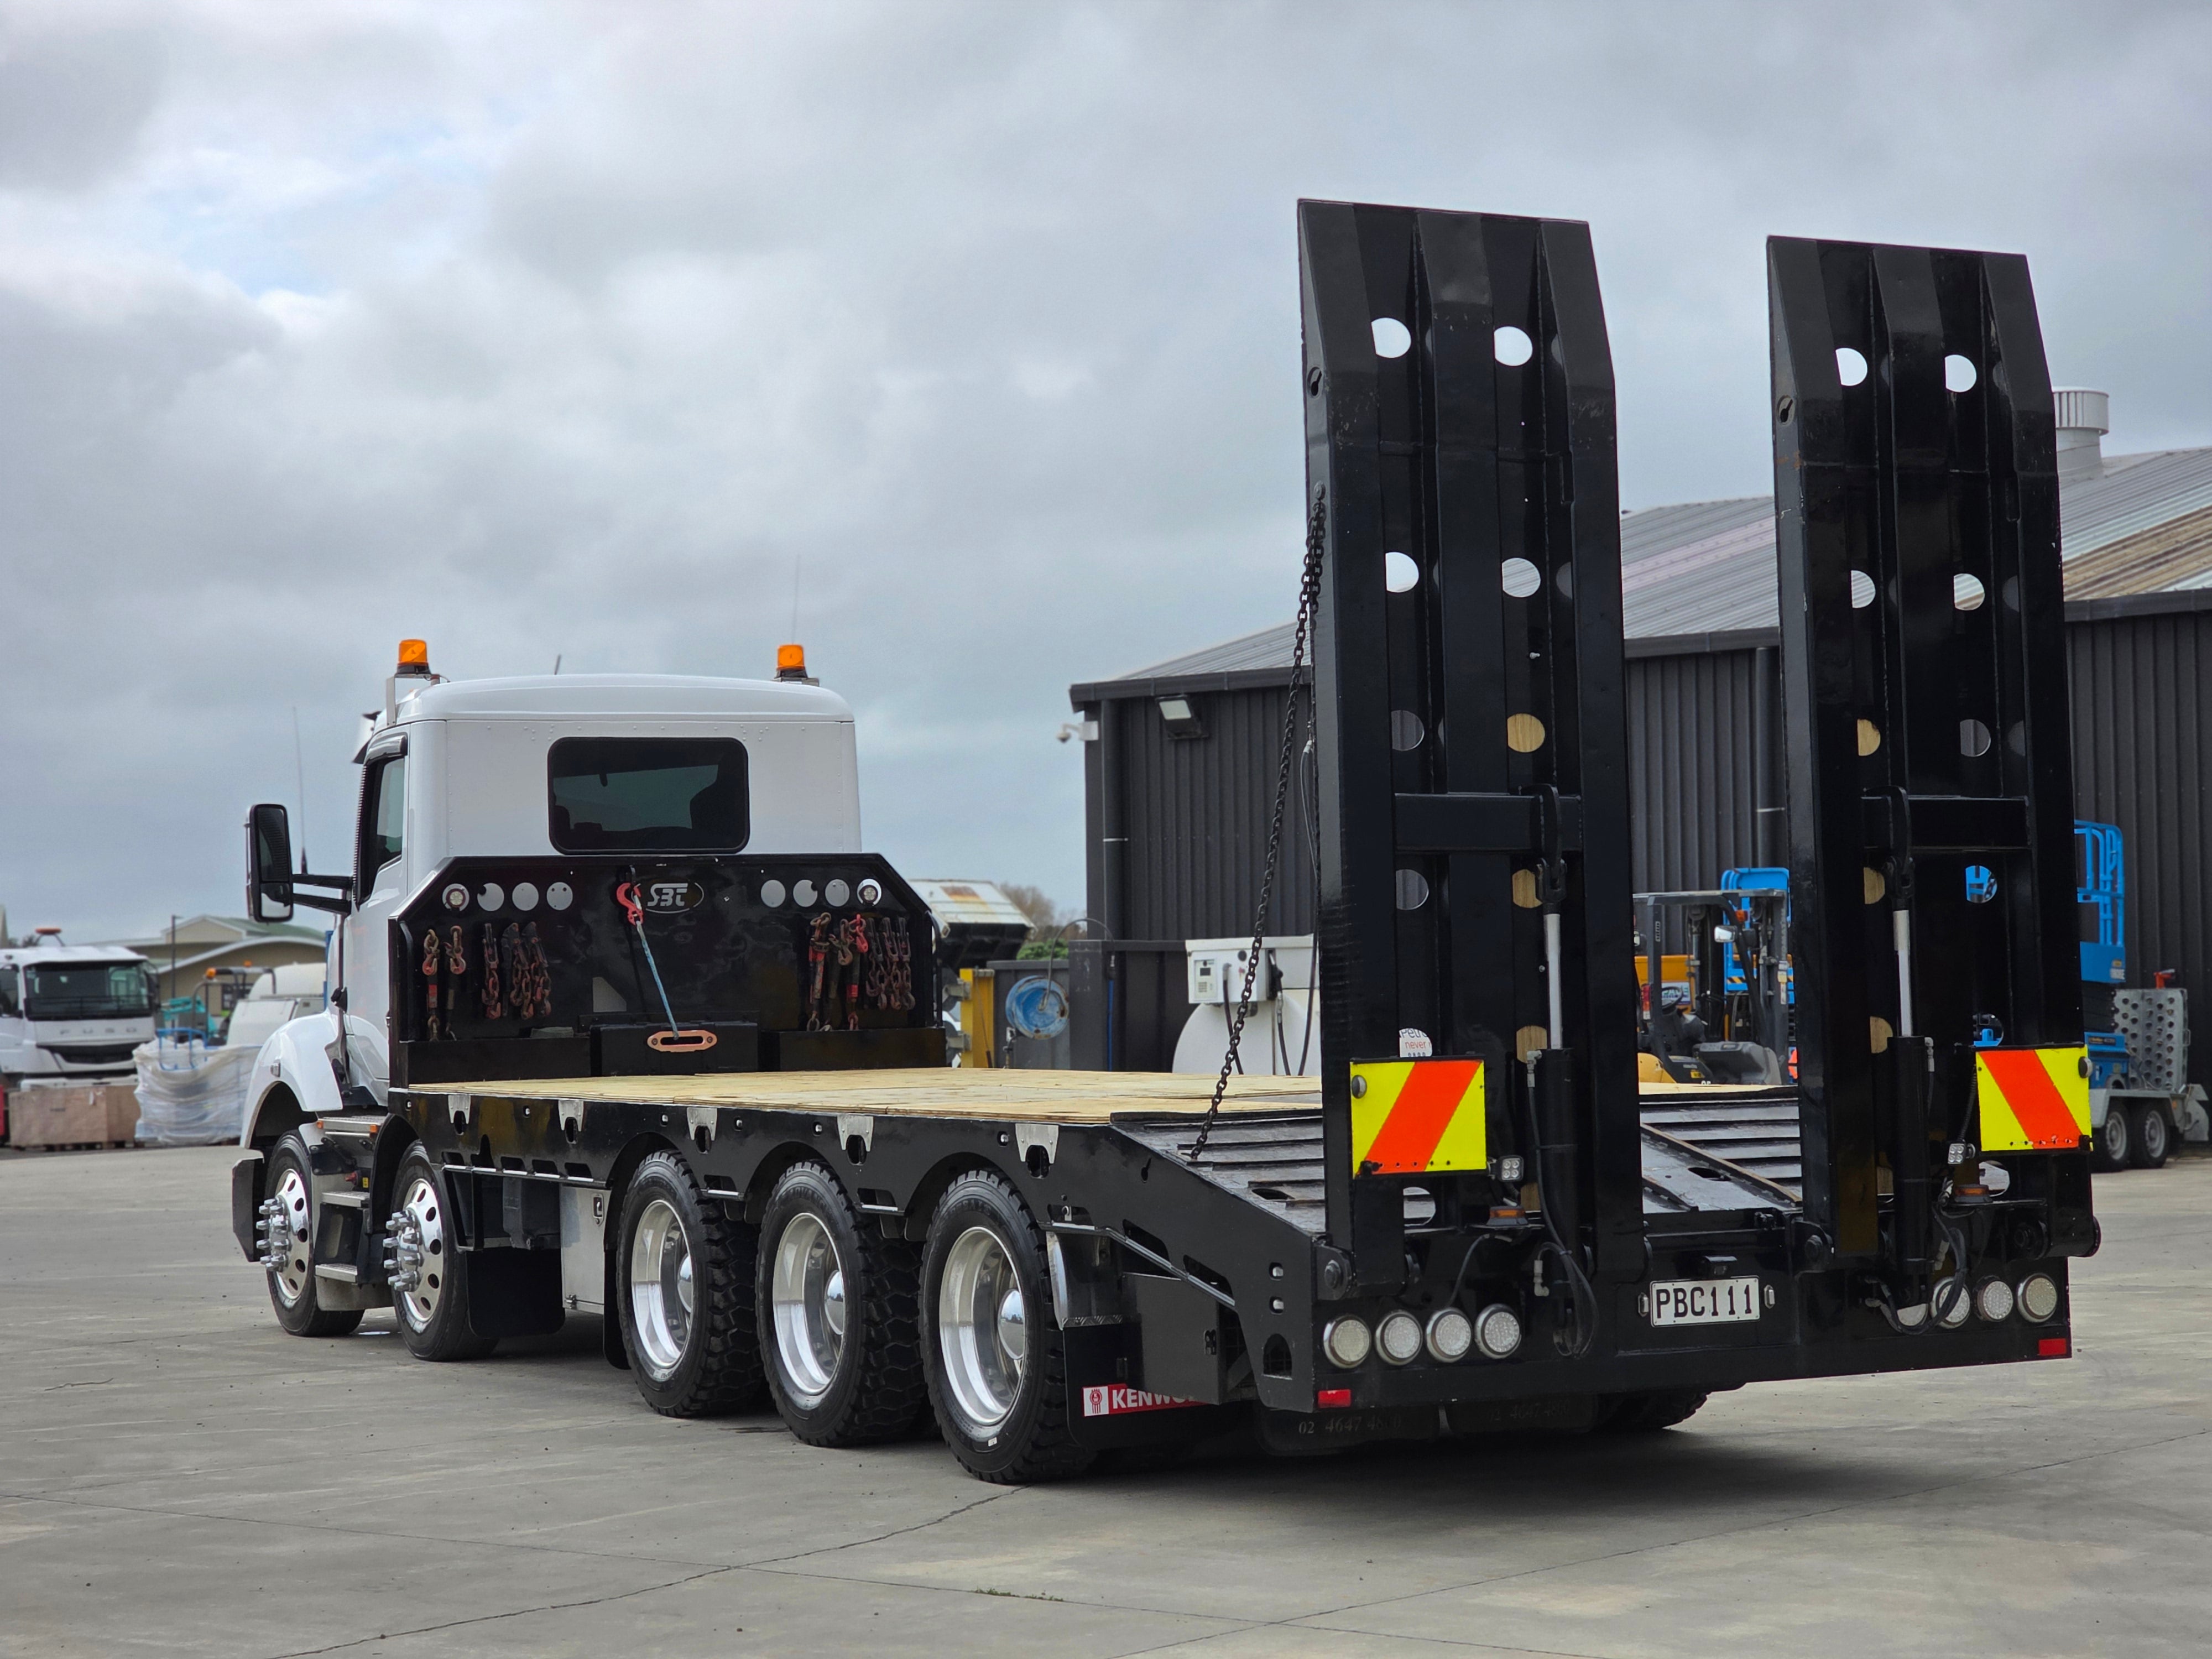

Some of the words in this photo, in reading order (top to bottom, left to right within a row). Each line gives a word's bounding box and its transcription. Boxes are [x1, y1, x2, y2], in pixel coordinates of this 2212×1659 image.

[1656, 1285, 1752, 1318] PBC111
[1113, 1389, 1193, 1408] KENW
[1298, 1421, 1314, 1434] 02
[1325, 1416, 1362, 1433] 4647
